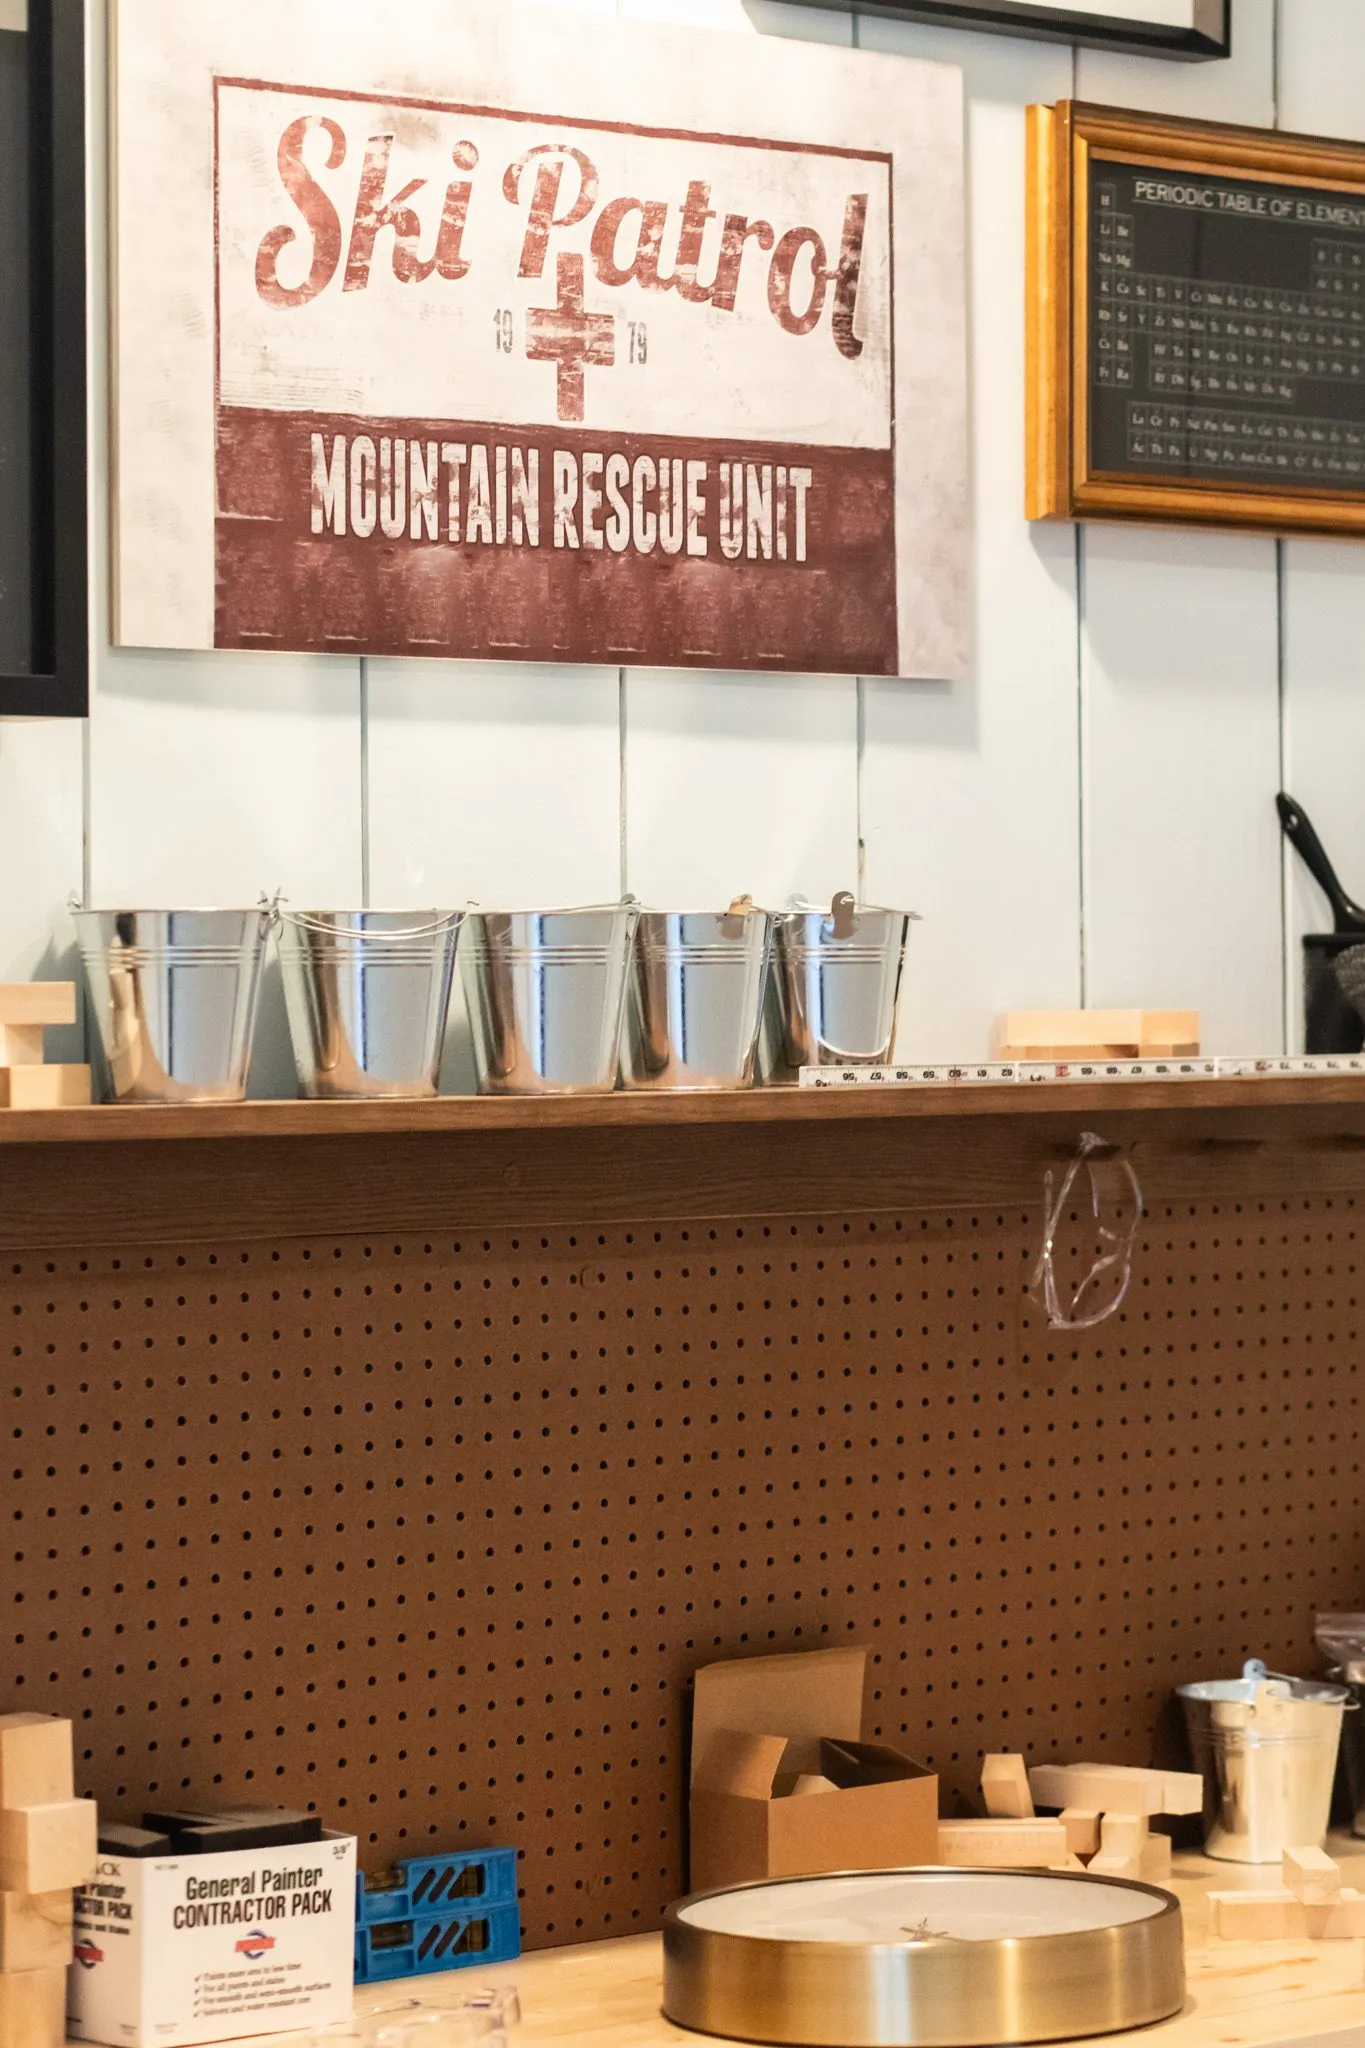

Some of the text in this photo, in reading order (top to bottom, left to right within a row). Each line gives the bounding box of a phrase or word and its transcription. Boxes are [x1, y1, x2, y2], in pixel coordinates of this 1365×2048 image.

[1135, 181, 1214, 208] PERIODIC
[1217, 191, 1267, 215] TABLE
[1269, 199, 1292, 217] OF
[254, 114, 869, 360] Ski Patrol
[626, 321, 647, 364] 79
[311, 432, 812, 562] MOUNTAIN RESCUE UNIT
[843, 1072, 855, 1081] 56
[870, 1072, 882, 1081] 57
[923, 1071, 935, 1079] 59
[186, 1867, 323, 1900] General Painter
[173, 1889, 333, 1930] CONTRACTOR PACK
